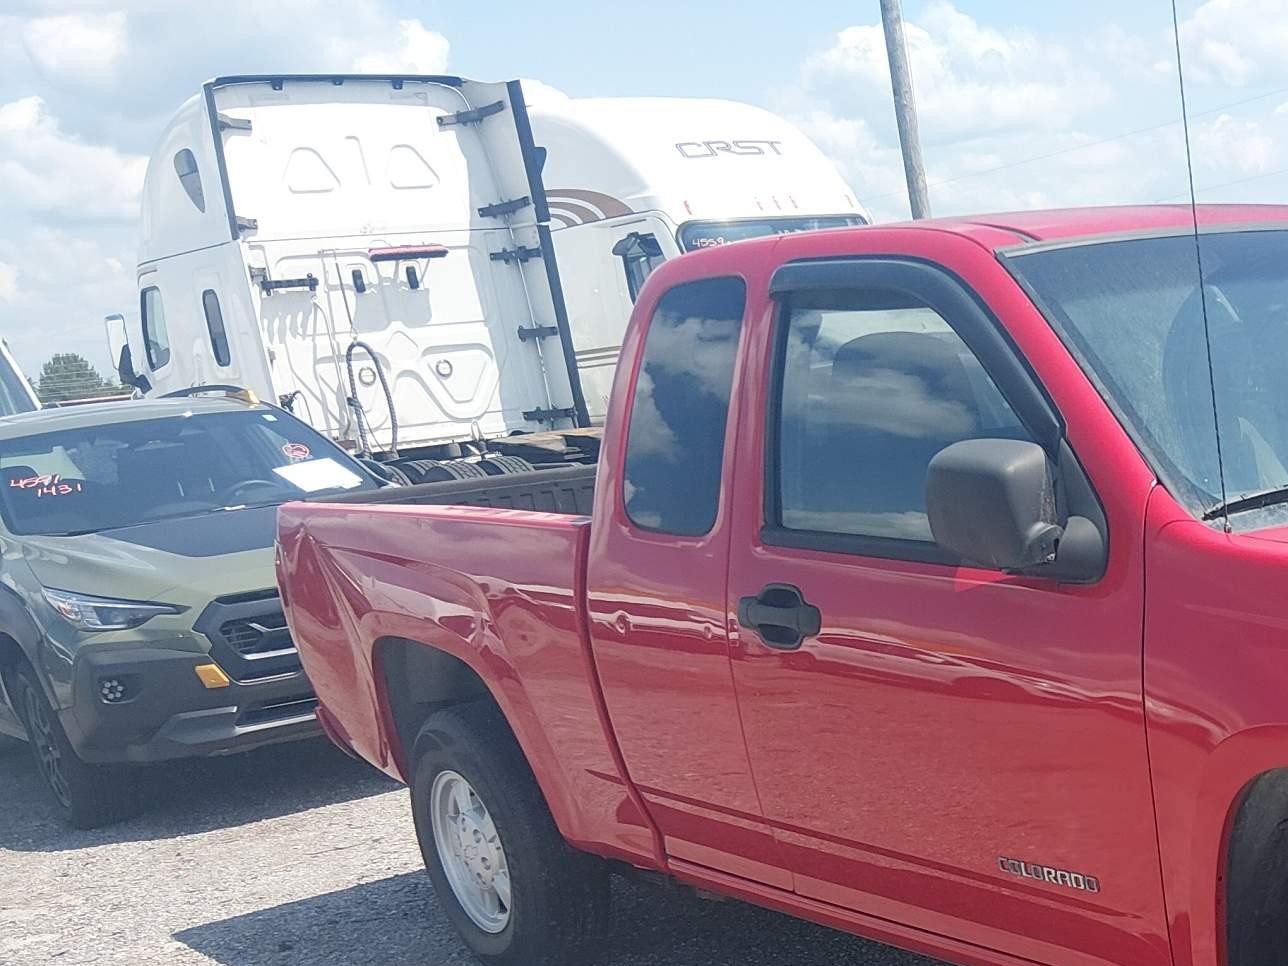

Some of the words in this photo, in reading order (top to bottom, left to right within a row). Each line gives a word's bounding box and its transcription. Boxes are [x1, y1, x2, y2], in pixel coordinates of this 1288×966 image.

[674, 140, 782, 158] CRST
[692, 236, 735, 248] 4559
[37, 483, 82, 498] 1431
[998, 856, 1101, 894] COLORADO
